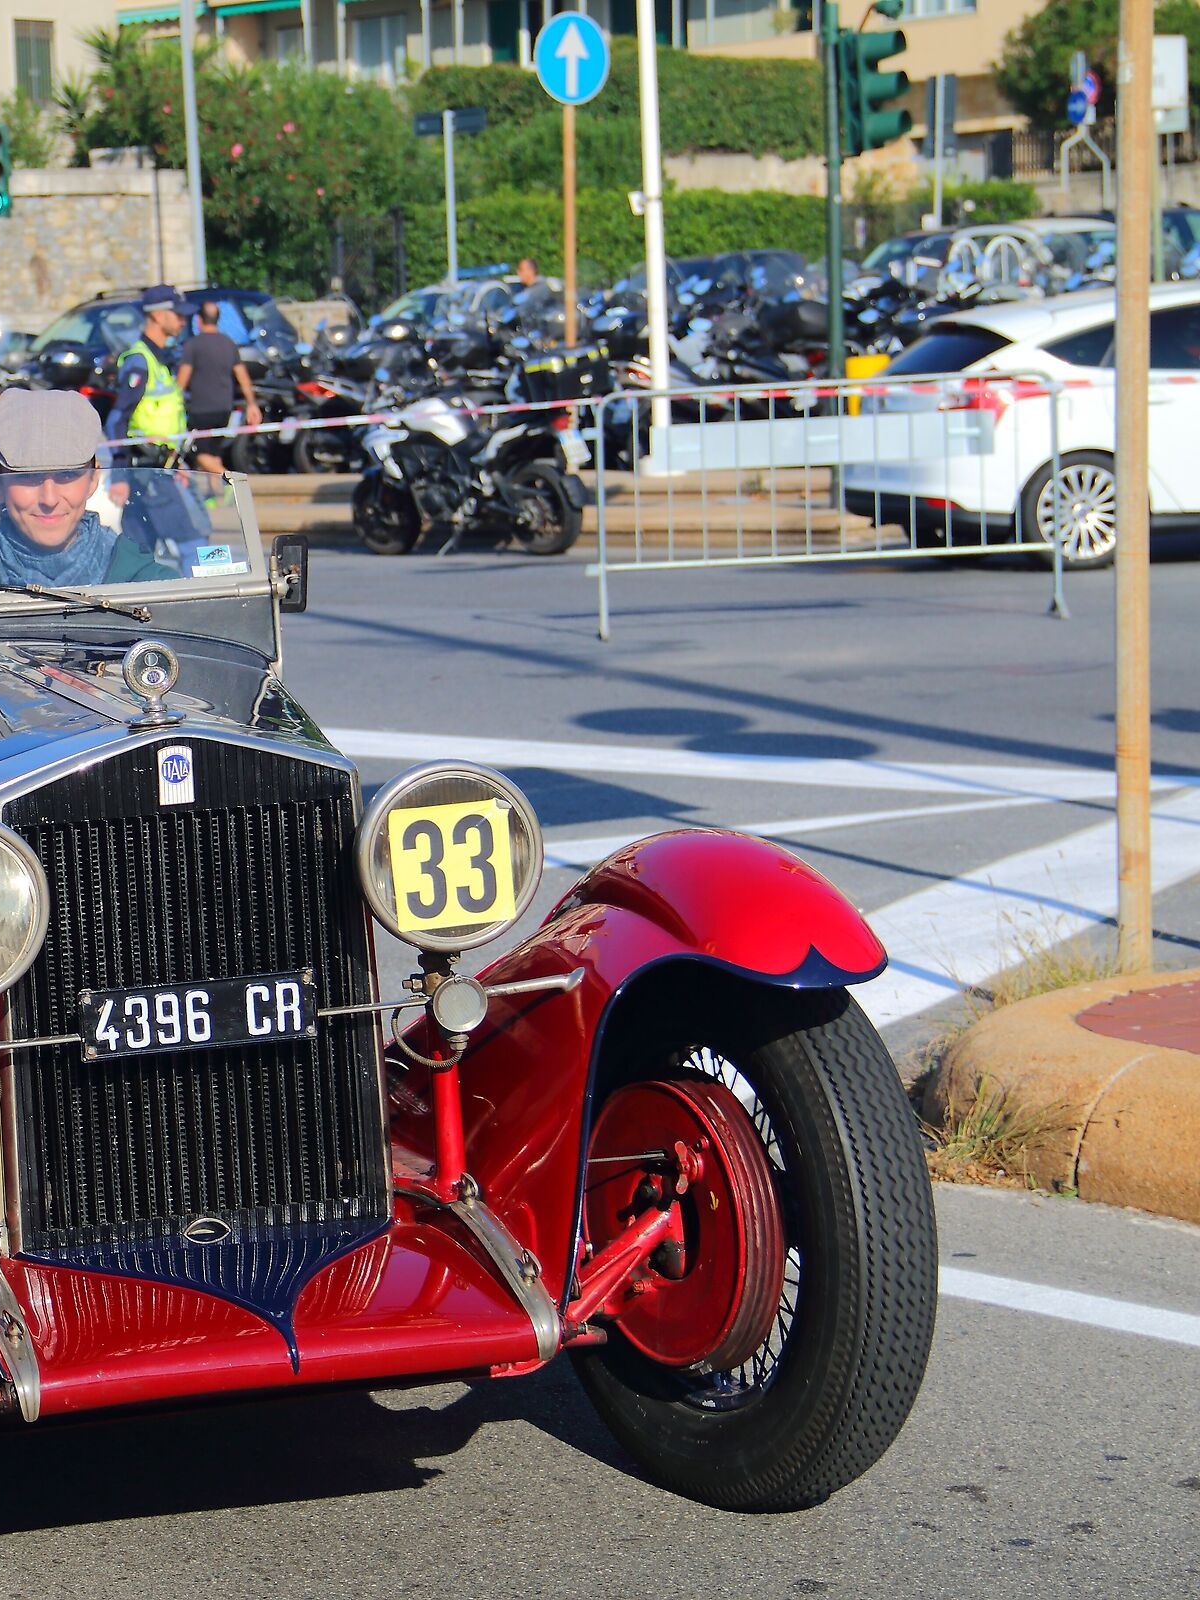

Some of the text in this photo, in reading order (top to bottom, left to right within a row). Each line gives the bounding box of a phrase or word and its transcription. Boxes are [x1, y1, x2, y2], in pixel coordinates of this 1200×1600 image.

[162, 757, 189, 781] ITALA
[402, 813, 497, 919] 33
[95, 979, 302, 1051] 4396 CR
